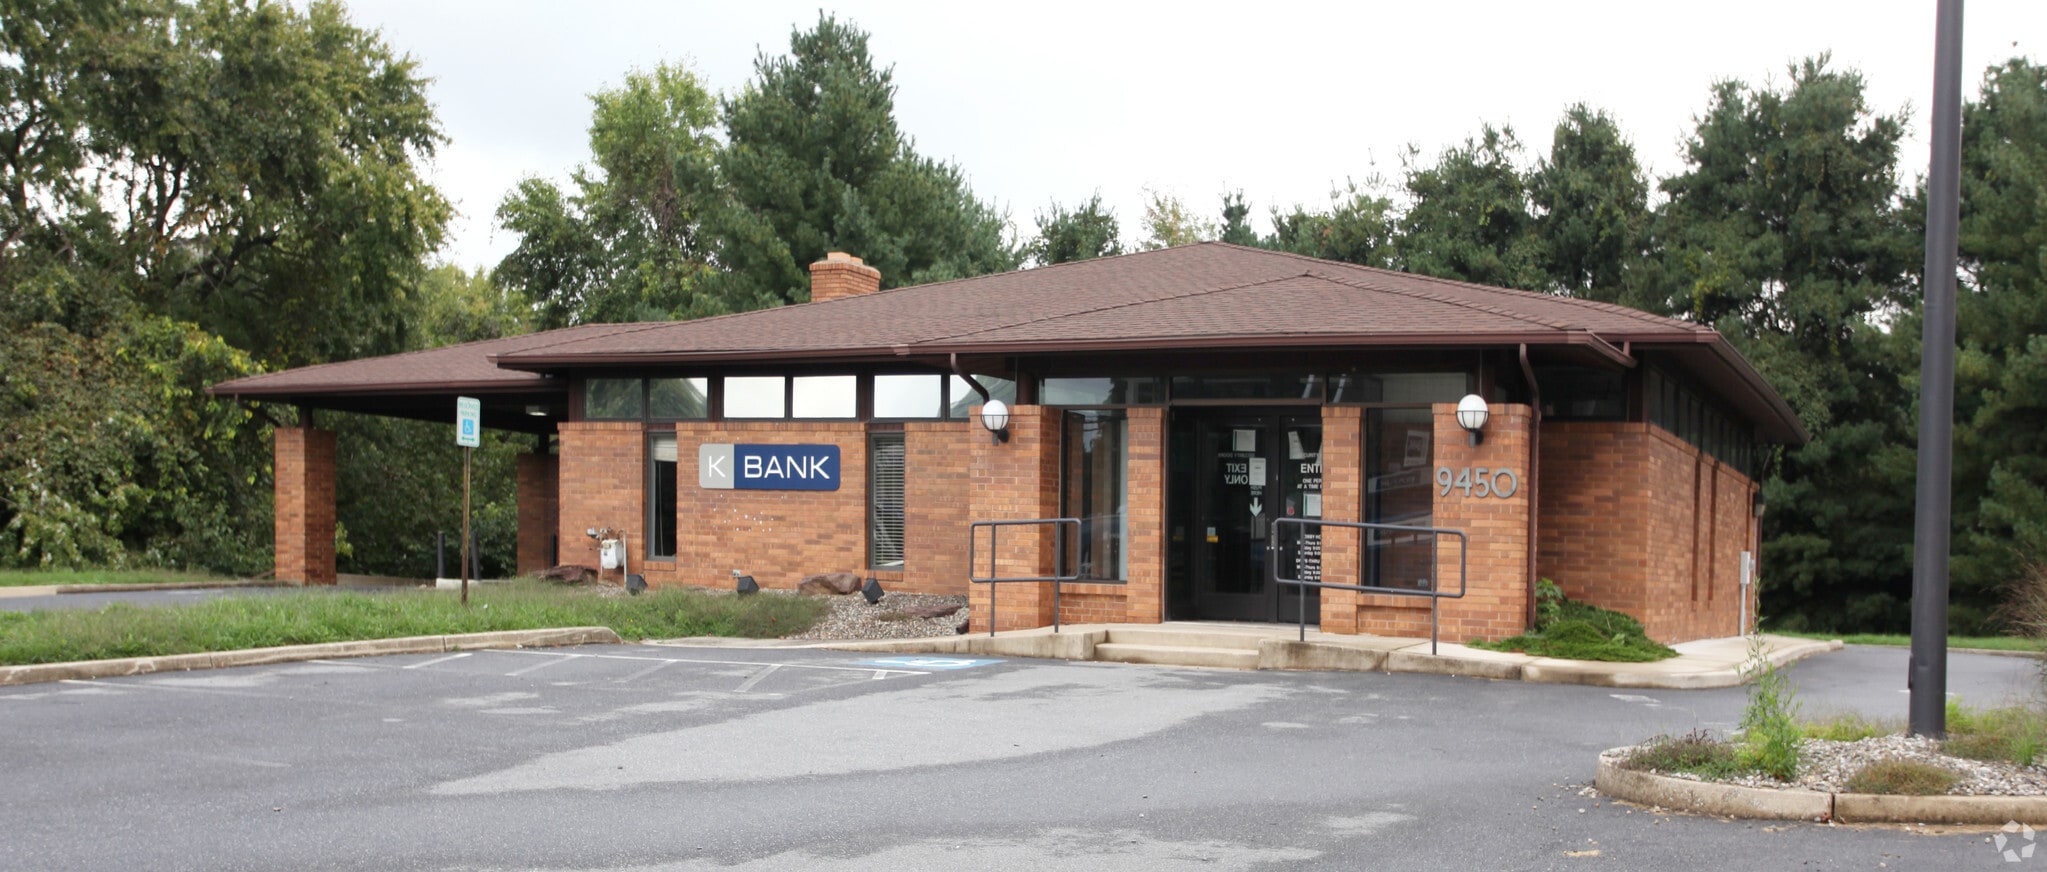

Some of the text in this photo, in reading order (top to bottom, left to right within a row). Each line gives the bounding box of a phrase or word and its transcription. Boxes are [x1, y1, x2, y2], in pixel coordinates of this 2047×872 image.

[708, 455, 831, 479] K BANK
[1436, 466, 1517, 499] 9450
